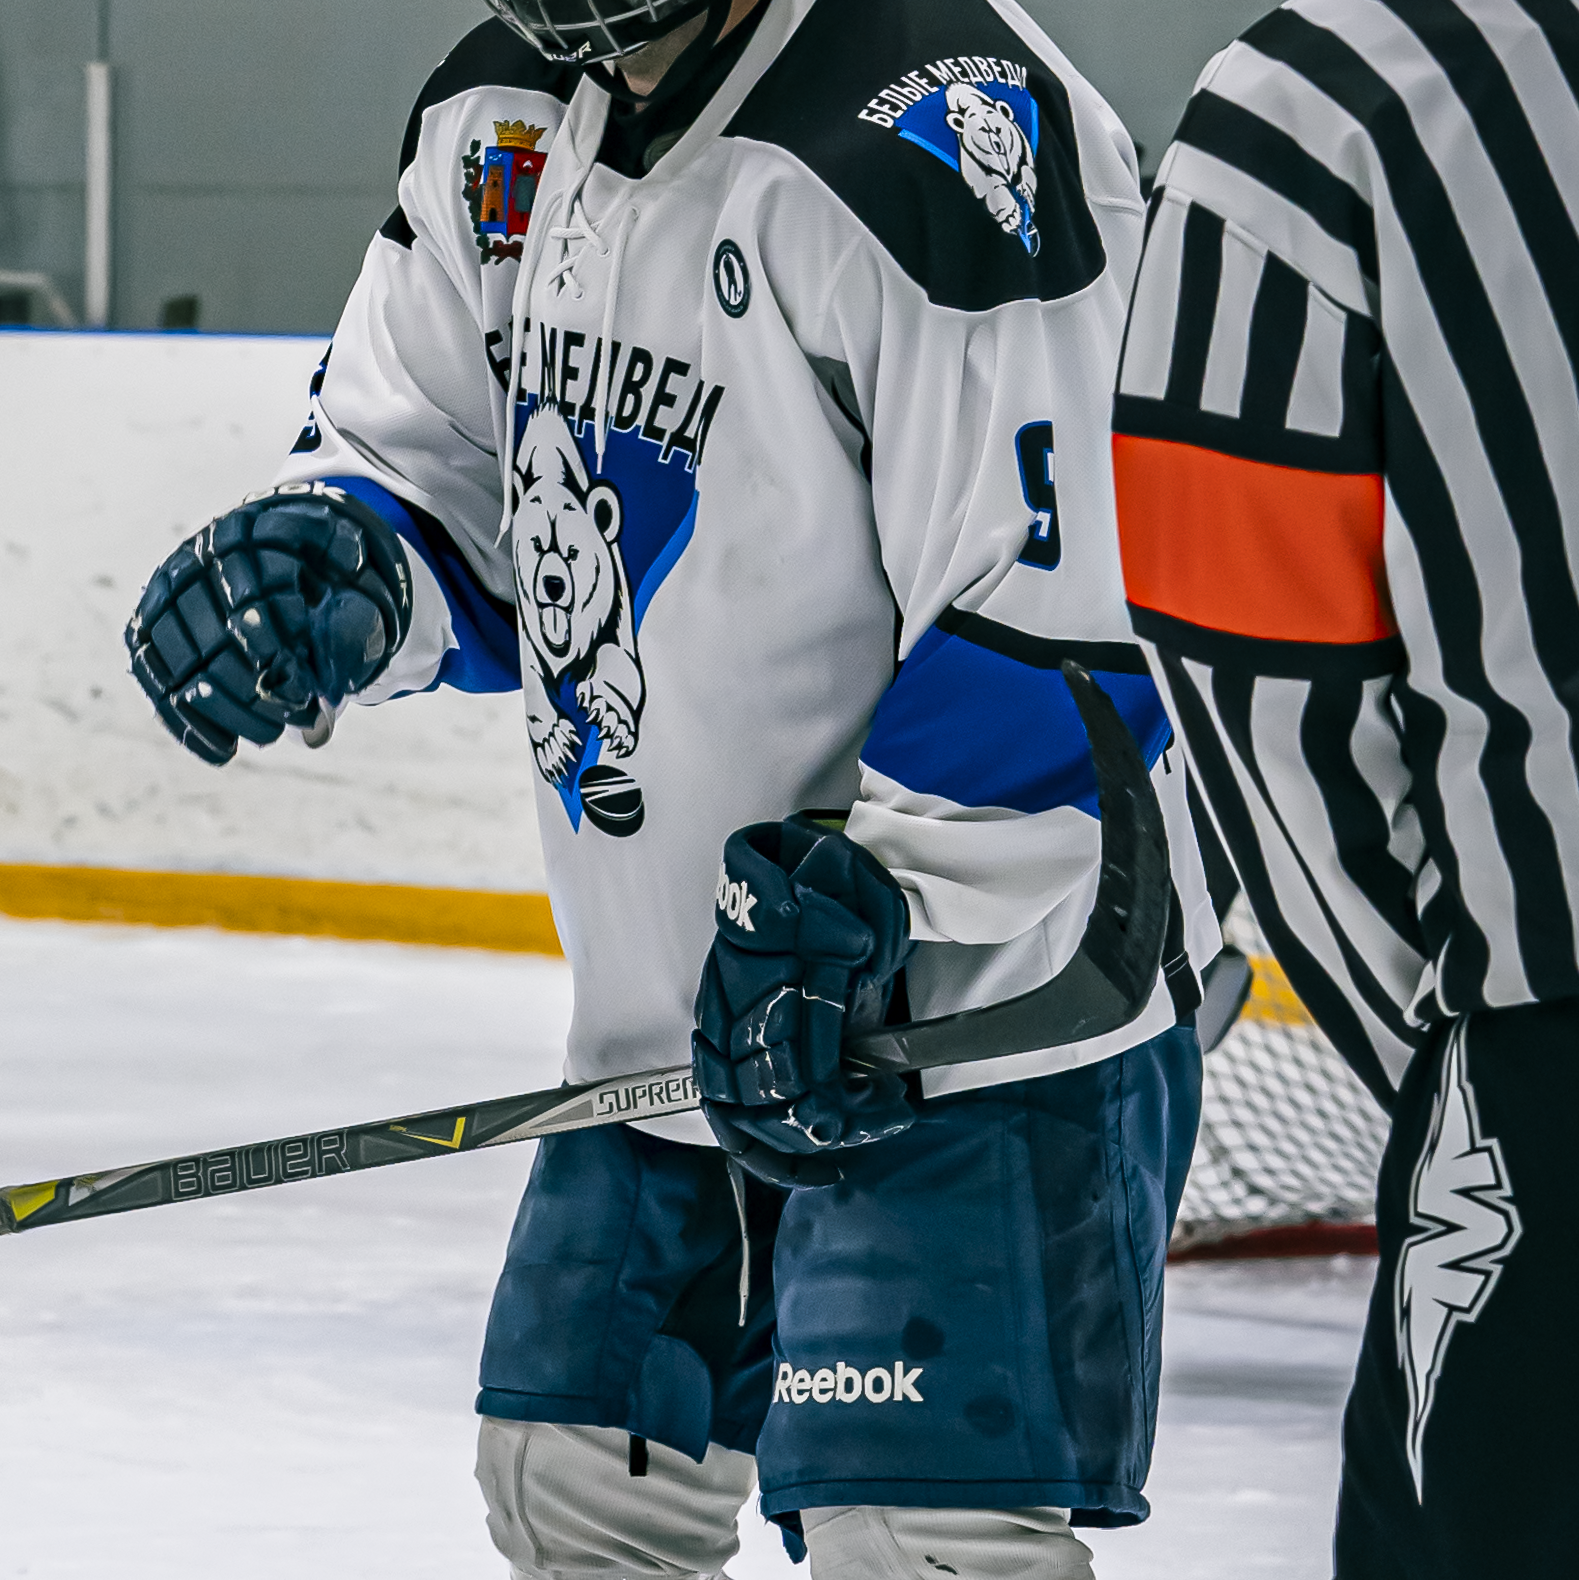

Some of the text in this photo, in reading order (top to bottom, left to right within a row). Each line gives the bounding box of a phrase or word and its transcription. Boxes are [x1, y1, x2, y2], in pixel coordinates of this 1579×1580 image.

[857, 56, 1027, 129] БЕЛЫЕ МЕДВЕДИ
[171, 1129, 350, 1201] BAUER
[773, 1361, 924, 1404] Reebok
